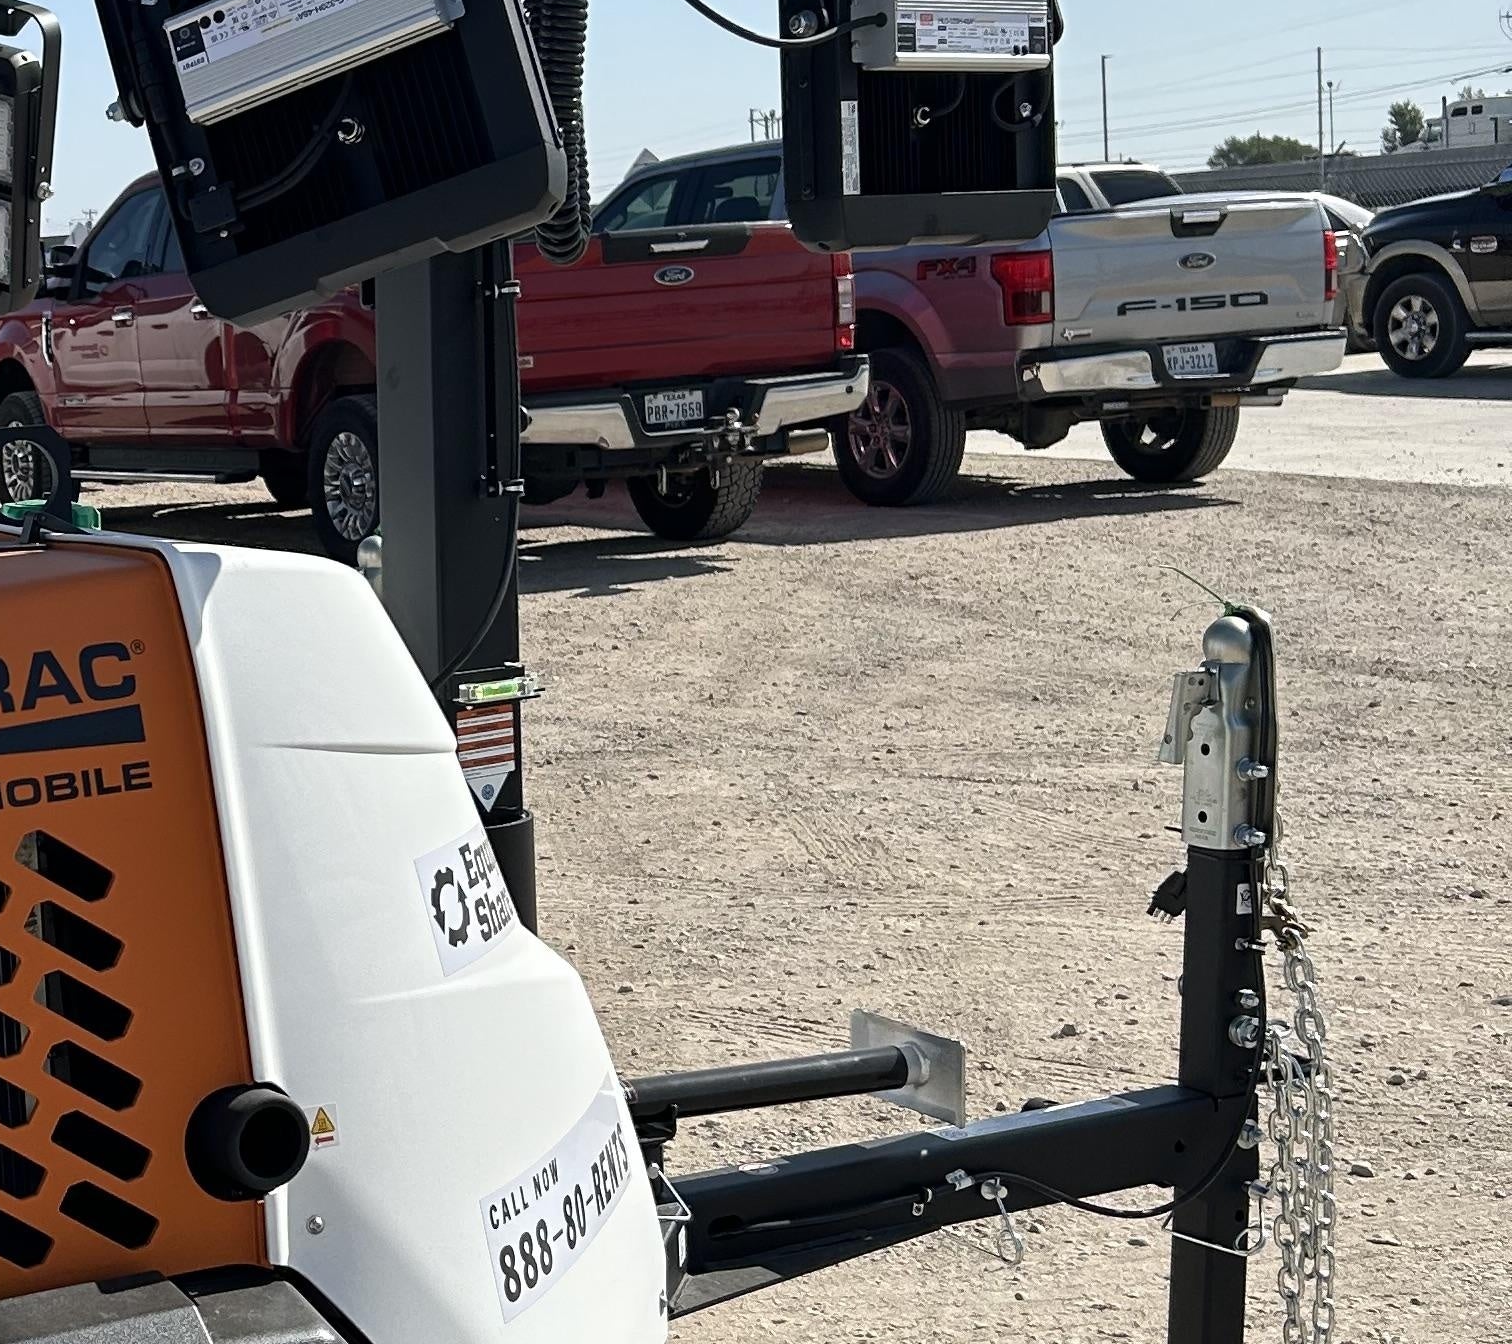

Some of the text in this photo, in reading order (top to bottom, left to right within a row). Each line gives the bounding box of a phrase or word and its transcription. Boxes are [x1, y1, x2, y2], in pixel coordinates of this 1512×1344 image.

[917, 256, 977, 281] FX4
[1117, 291, 1269, 317] F-150
[489, 1157, 559, 1230] CALL NOW
[499, 1122, 629, 1303] 888-80-RENTS
